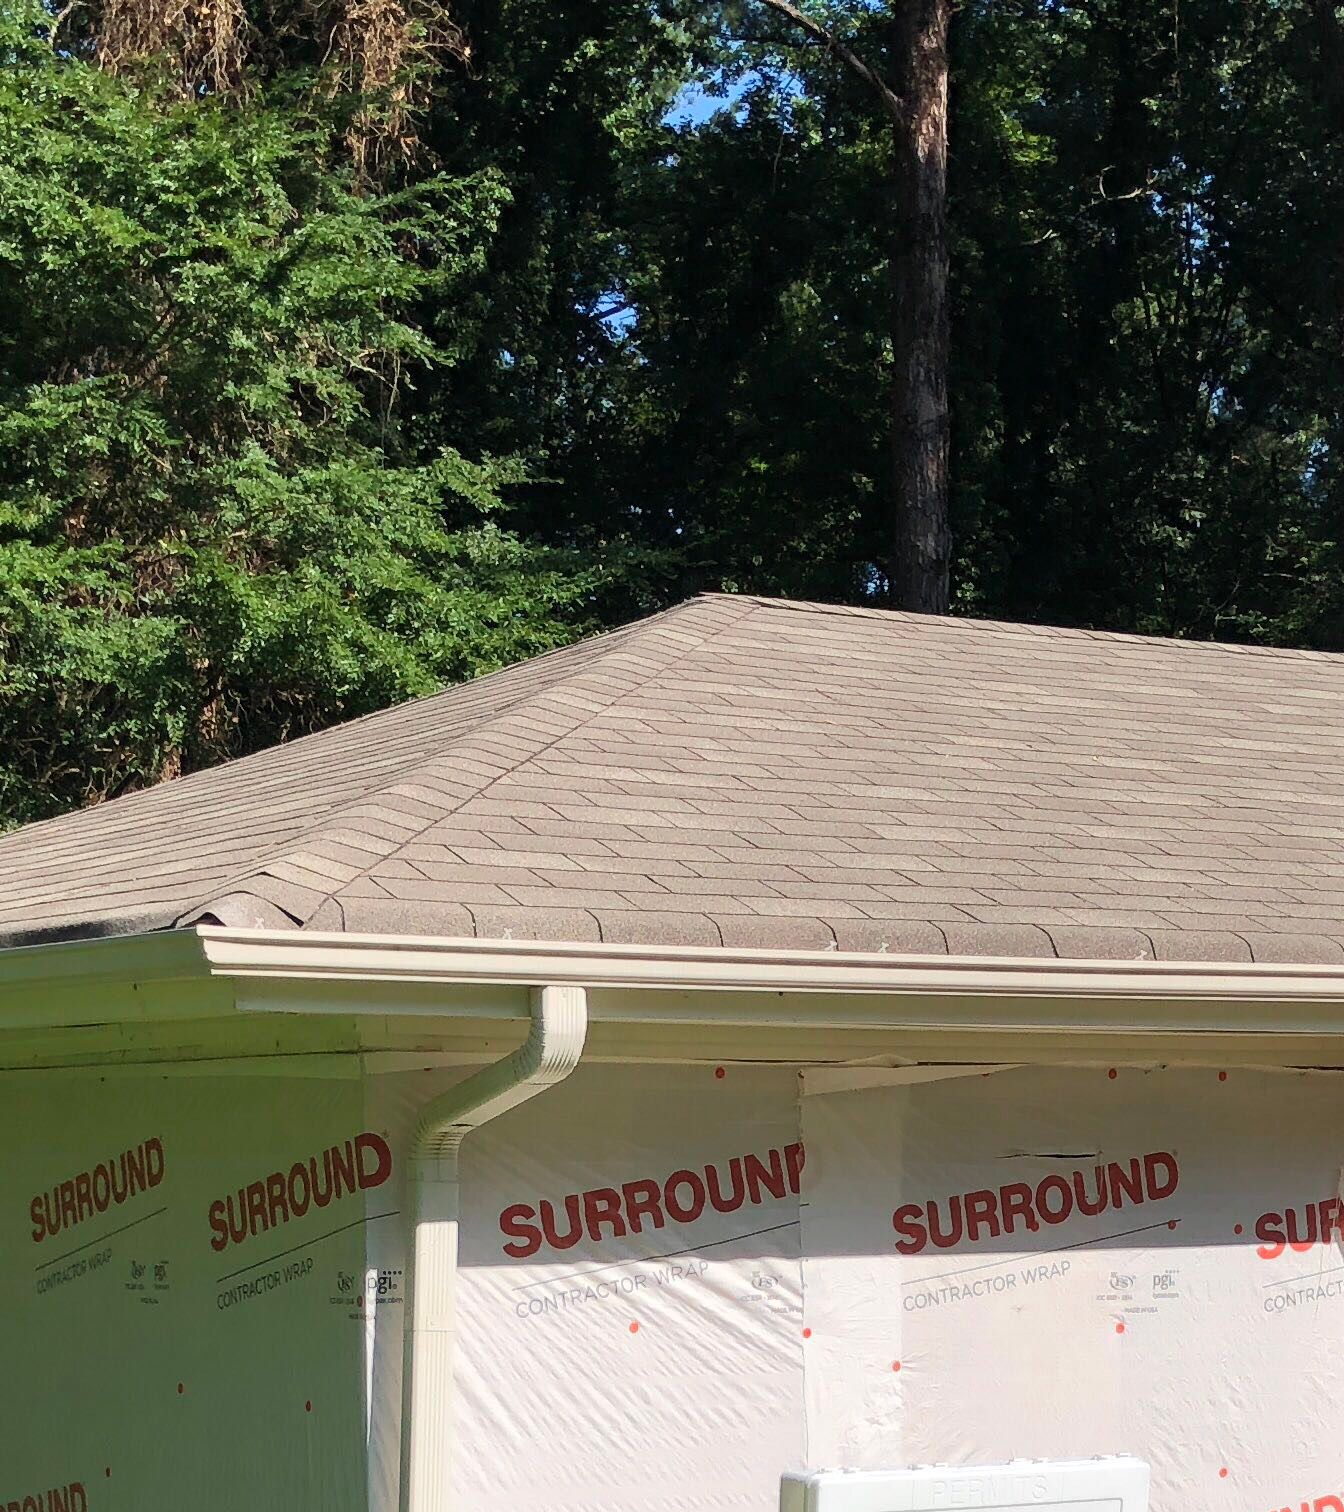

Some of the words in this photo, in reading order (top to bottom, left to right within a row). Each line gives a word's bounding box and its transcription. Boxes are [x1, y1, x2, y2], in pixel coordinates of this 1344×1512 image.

[30, 1136, 166, 1243] SURROUND
[209, 1131, 393, 1252] SURROUND
[893, 1150, 1180, 1256] SURROUND
[216, 1273, 282, 1311] CONTRACTOR
[283, 1257, 315, 1287] WRAP
[515, 1274, 648, 1320] CONTRACTOR
[655, 1260, 711, 1287] WRAP
[902, 1275, 1017, 1313] CONTRACTOR
[1018, 1259, 1072, 1290] WRAP
